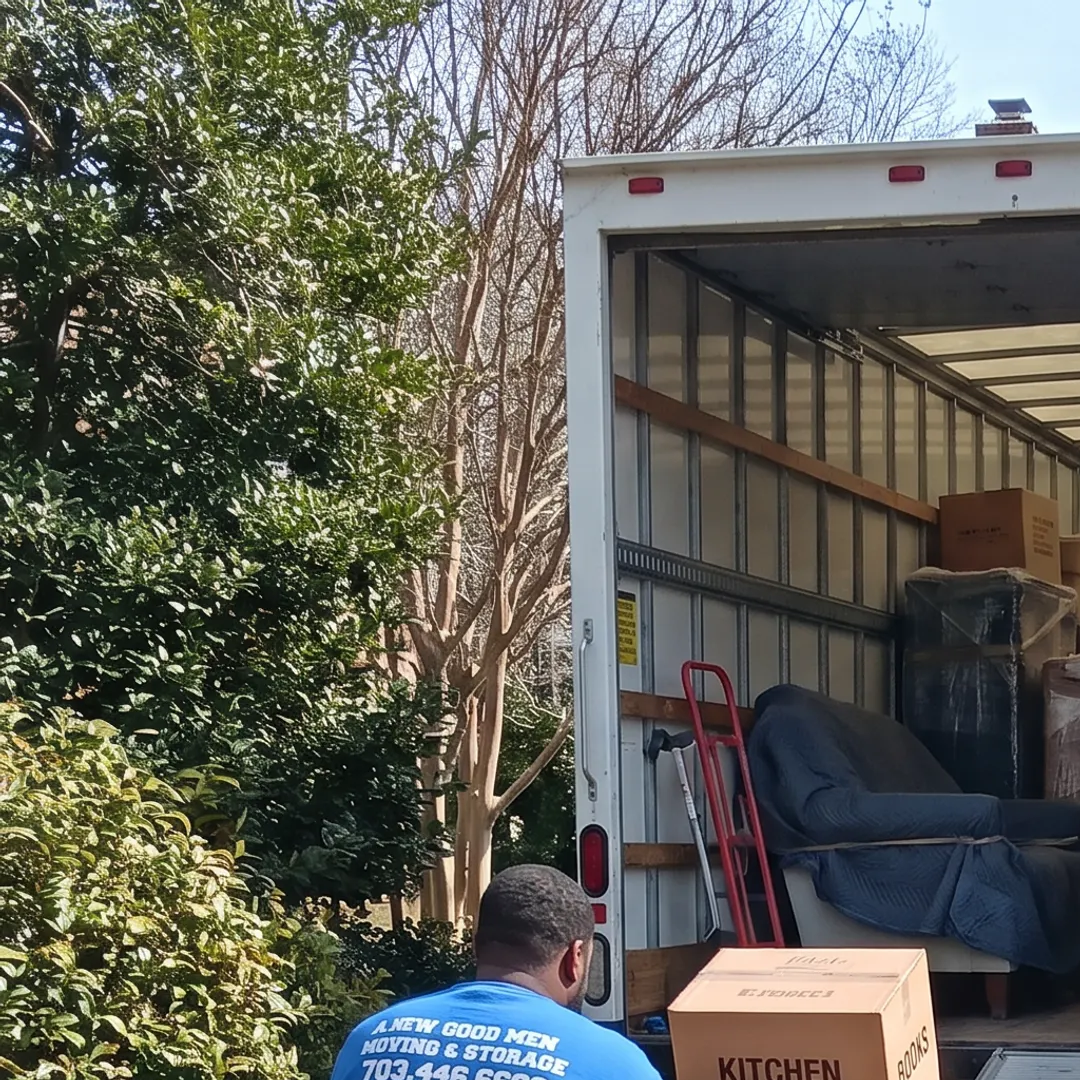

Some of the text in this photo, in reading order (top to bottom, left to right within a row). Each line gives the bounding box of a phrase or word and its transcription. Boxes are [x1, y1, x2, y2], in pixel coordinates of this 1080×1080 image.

[442, 1022, 501, 1041] GOOD
[504, 1029, 560, 1051] MEN
[361, 1037, 569, 1076] MOVING & STORAGE
